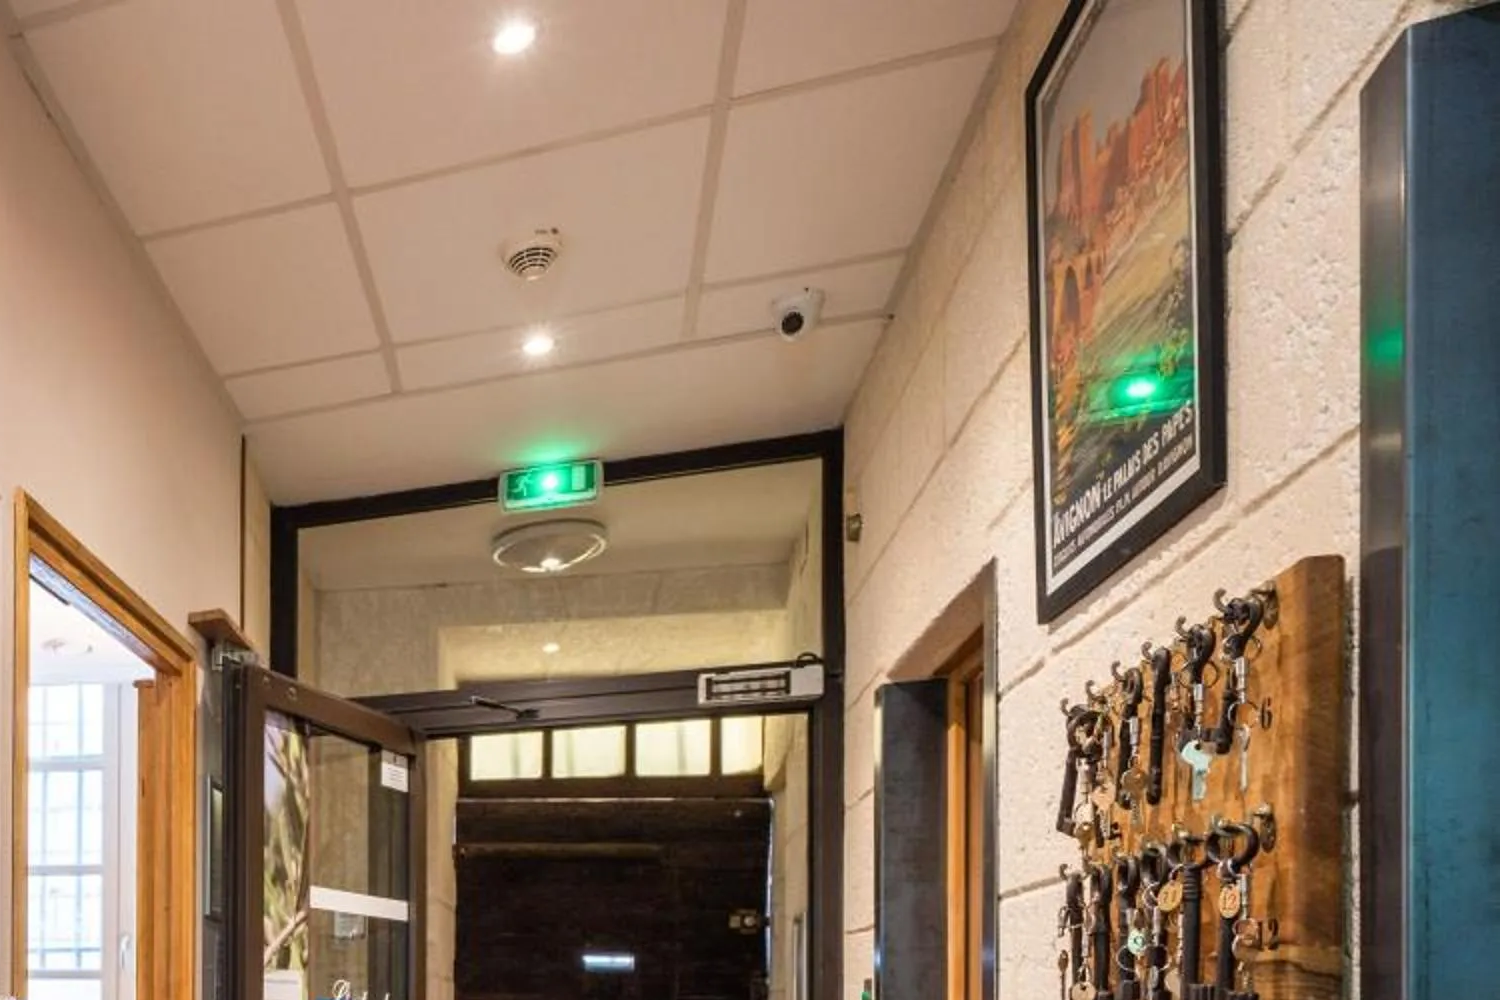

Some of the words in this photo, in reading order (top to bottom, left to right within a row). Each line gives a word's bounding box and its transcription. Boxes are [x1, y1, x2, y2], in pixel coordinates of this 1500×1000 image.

[1053, 483, 1101, 549] AVIGNON
[1114, 450, 1141, 493] PALAIS
[1162, 403, 1193, 448] PAPES
[1261, 697, 1273, 731] 6
[1257, 919, 1279, 952] 12
